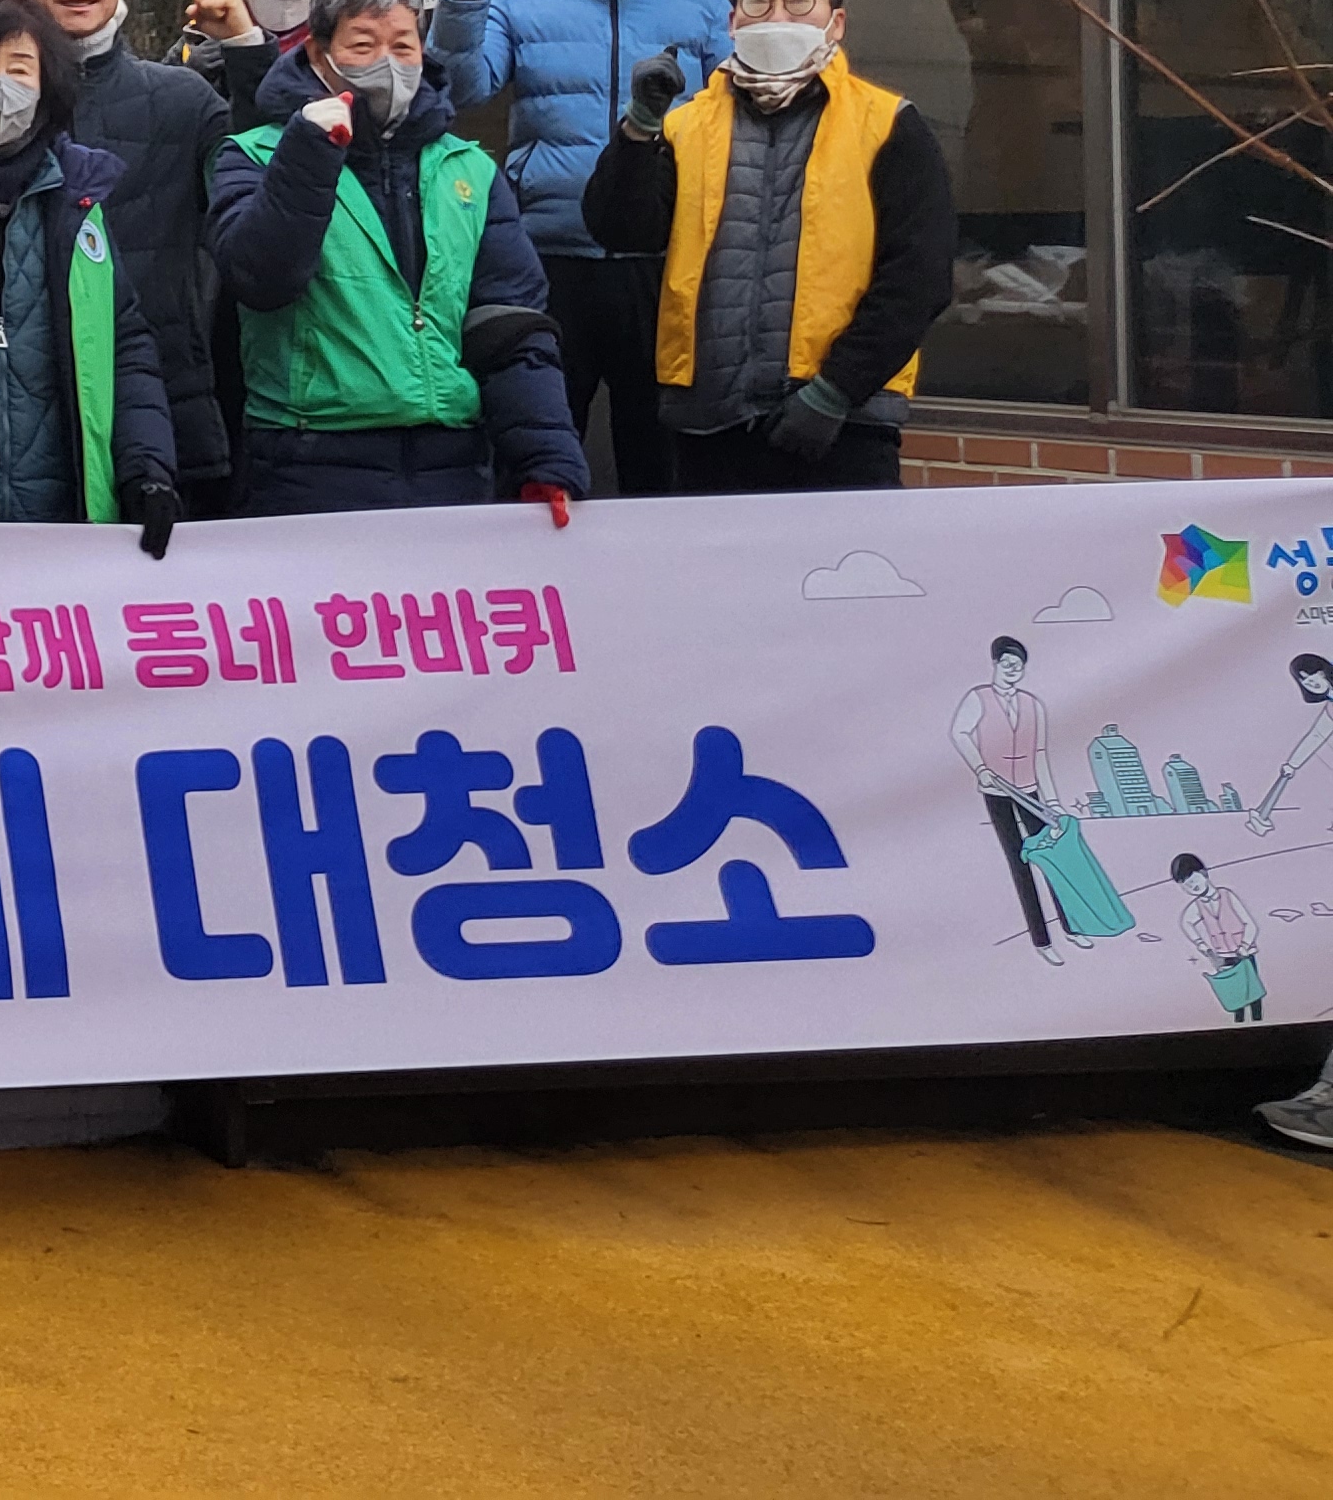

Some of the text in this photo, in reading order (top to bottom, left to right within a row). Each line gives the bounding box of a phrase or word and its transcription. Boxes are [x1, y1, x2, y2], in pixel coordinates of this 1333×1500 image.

[122, 596, 297, 689] 동네
[314, 585, 576, 681] 한바퀴
[134, 726, 877, 989] 대청소
